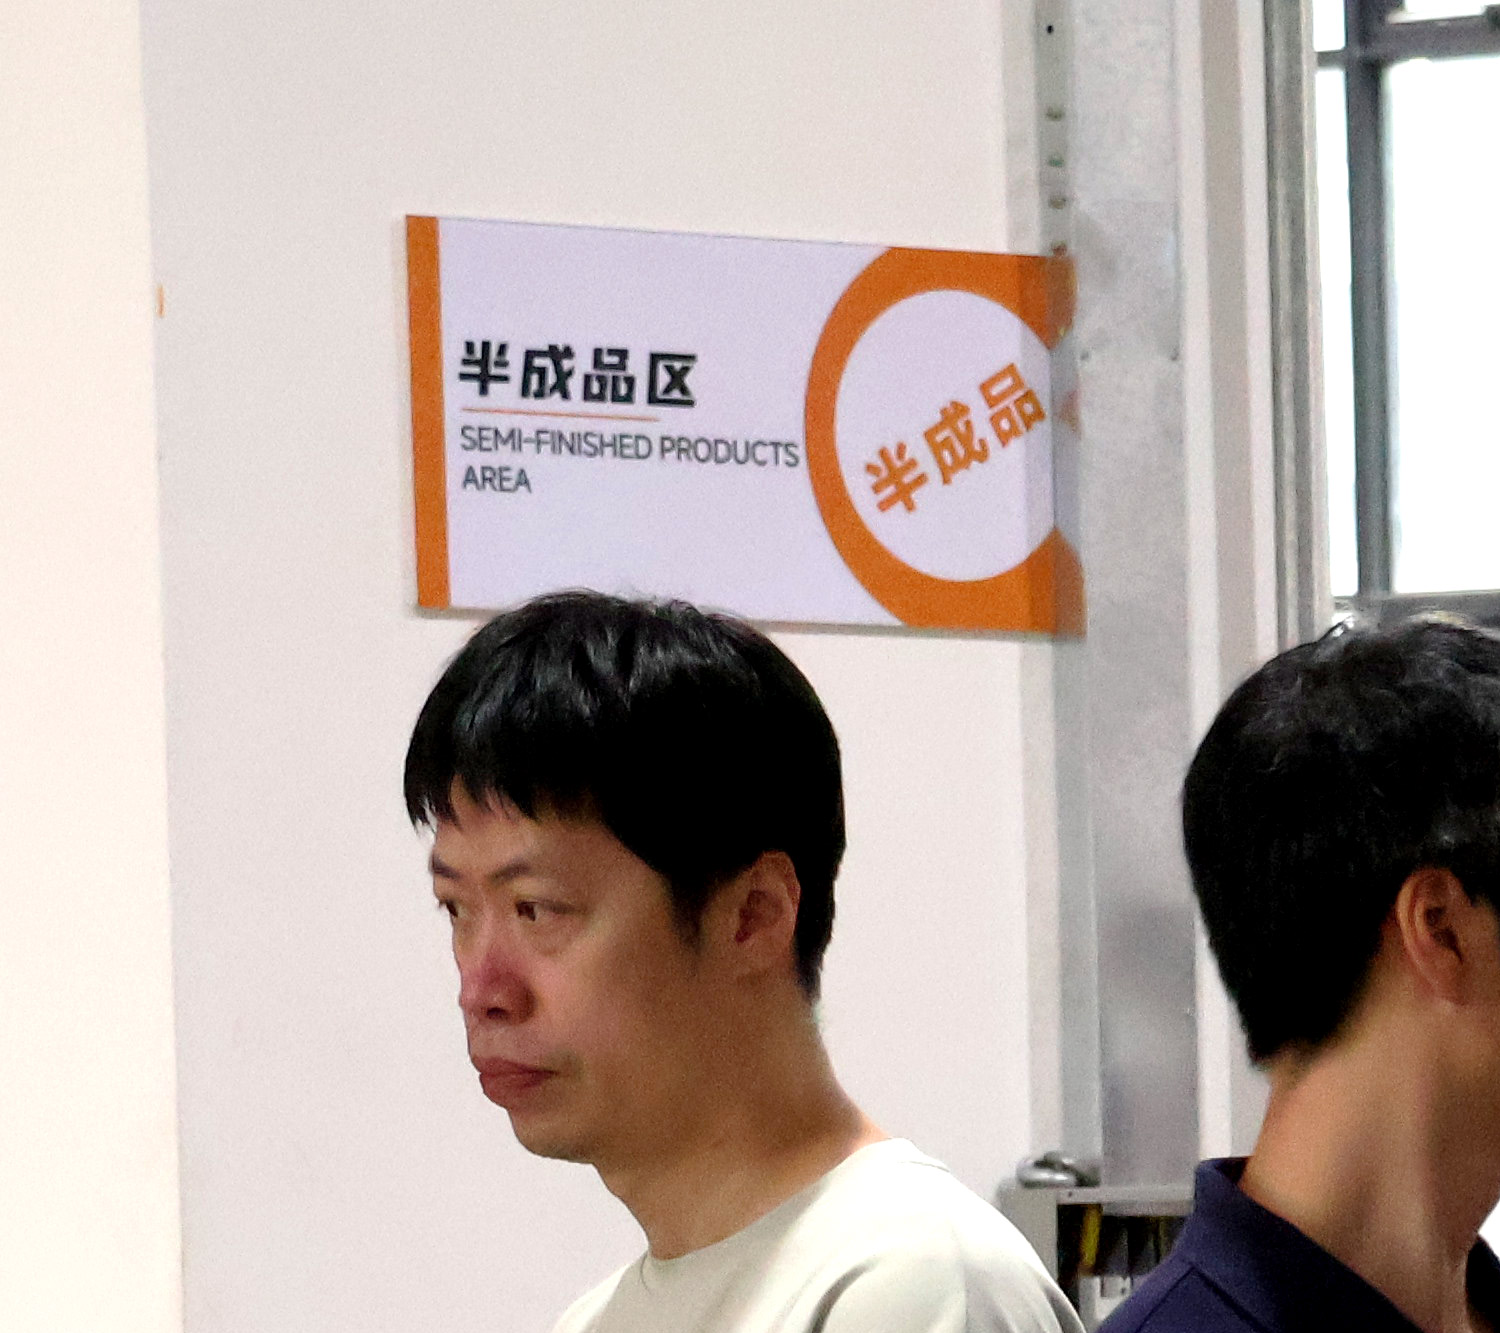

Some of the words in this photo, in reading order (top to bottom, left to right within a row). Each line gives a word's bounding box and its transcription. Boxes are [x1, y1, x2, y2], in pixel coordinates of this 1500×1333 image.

[457, 338, 698, 408] 半成品区
[459, 424, 653, 462] SEMI-FINISHED
[659, 436, 800, 469] PRODUCTS
[863, 362, 1047, 515] 半成品
[461, 465, 533, 495] AREA
